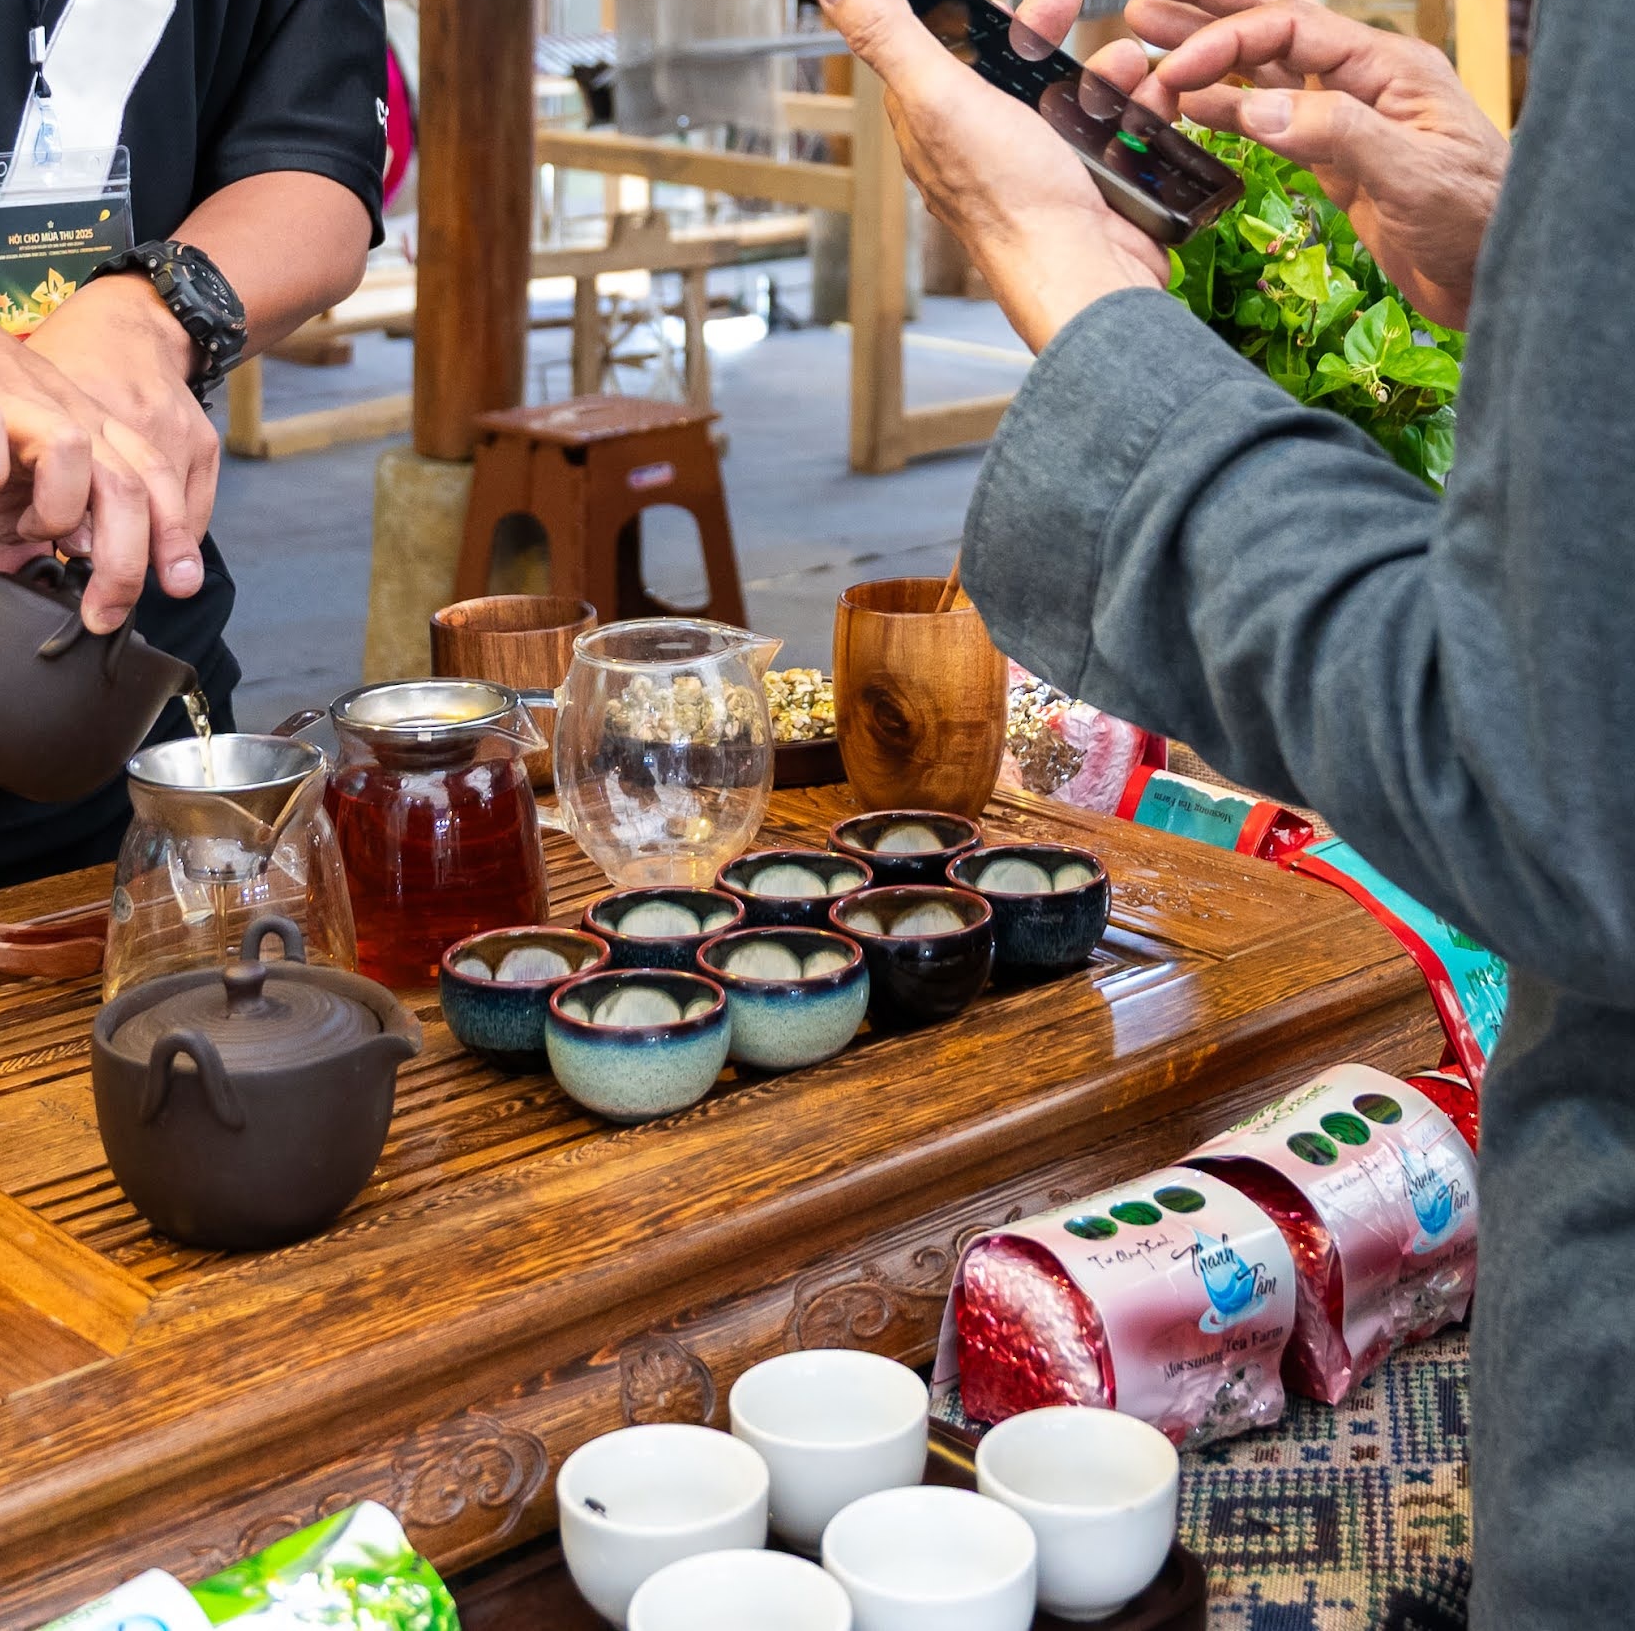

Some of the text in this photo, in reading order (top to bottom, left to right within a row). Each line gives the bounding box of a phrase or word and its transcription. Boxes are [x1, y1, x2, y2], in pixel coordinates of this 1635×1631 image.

[75, 228, 94, 240] 2025
[1153, 792, 1176, 807] Farm
[1170, 1232, 1277, 1301] Thanh Tâm
[1224, 1335, 1248, 1353] Tea
[1250, 1325, 1284, 1347] Farm
